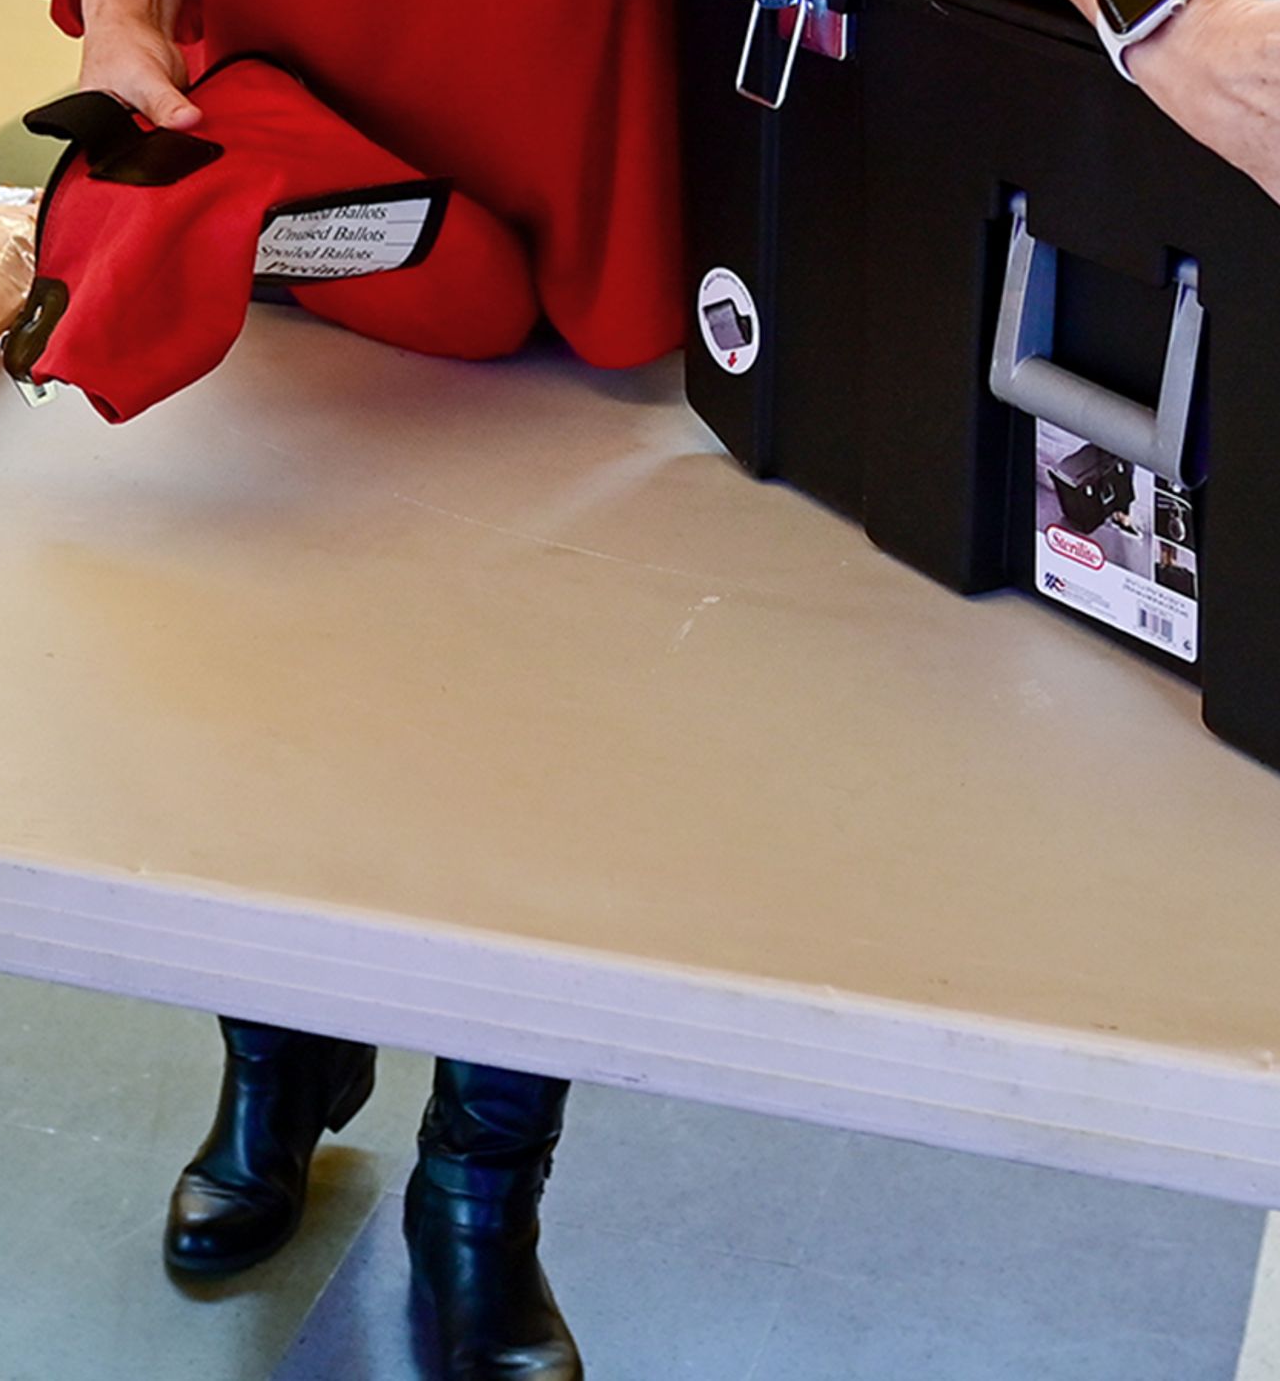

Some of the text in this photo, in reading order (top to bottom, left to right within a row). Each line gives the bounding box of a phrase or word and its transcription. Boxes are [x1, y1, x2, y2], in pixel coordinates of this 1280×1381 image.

[334, 203, 388, 220] Ballots
[273, 226, 387, 242] Unused Ballots
[261, 245, 374, 260] Spoiled Ballots
[1051, 530, 1102, 565] Sterilite
